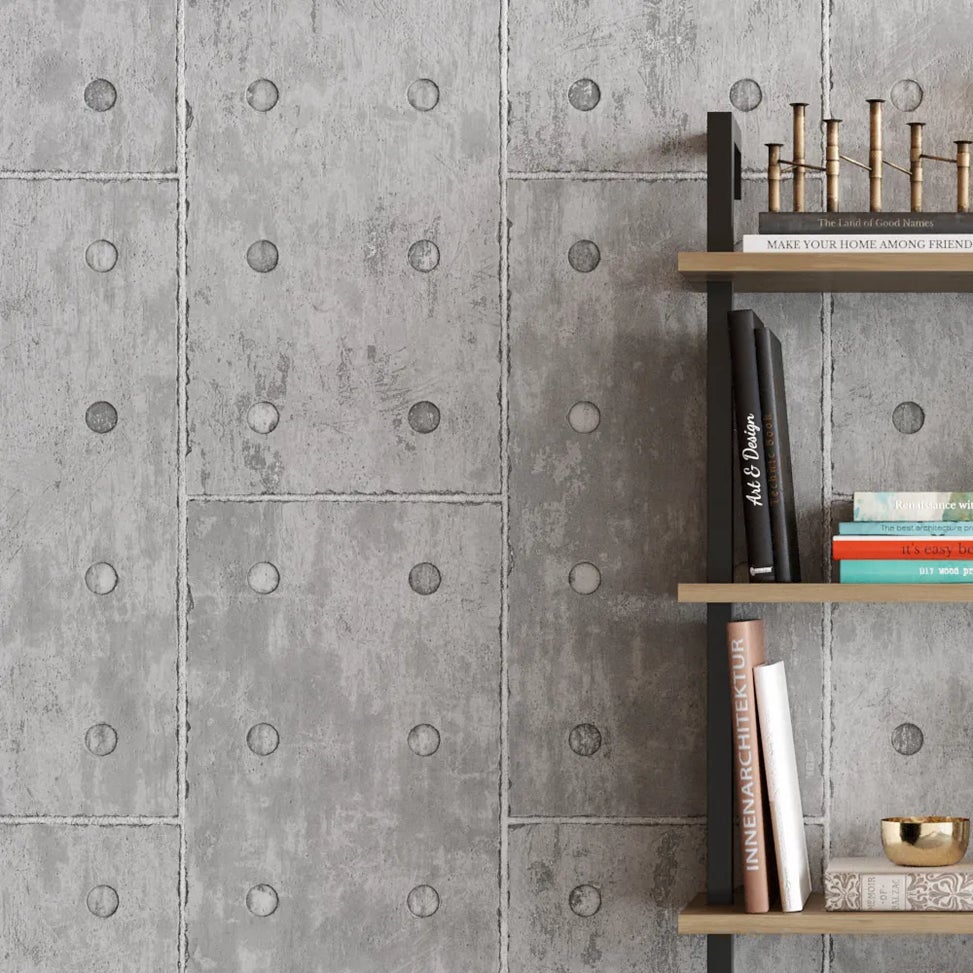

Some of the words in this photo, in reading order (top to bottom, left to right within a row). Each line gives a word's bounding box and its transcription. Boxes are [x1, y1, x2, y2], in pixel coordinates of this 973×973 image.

[818, 218, 836, 228] The
[838, 218, 862, 228] Land
[863, 218, 874, 228] of
[875, 218, 901, 228] Good
[902, 218, 934, 228] Names
[767, 240, 801, 249] MAKE
[803, 240, 838, 249] YOUR
[842, 240, 877, 249] HOME
[879, 240, 926, 249] AMONG
[742, 413, 761, 461] Design
[744, 463, 761, 477] &
[745, 477, 763, 507] Art
[881, 524, 895, 532] The
[896, 524, 914, 532] best
[902, 542, 920, 555] it's
[923, 545, 953, 558] easy
[731, 638, 760, 872] INNENARCHITEKTUR
